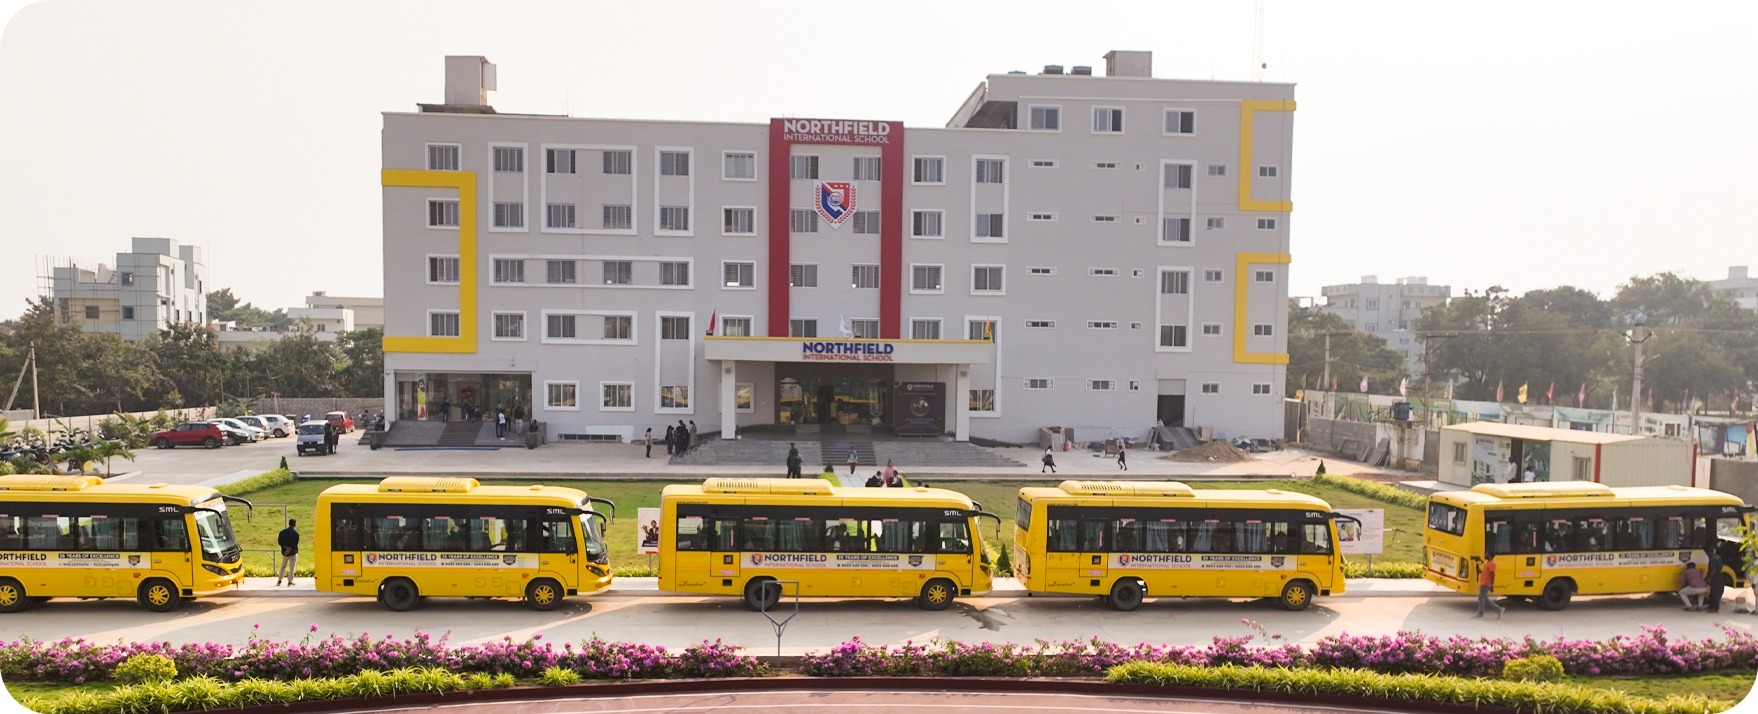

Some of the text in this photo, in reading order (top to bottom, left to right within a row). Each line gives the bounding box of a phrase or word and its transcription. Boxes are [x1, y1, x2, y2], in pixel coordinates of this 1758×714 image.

[784, 119, 890, 135] NORTHFIELD
[783, 133, 890, 144] INTERNATIONAL SCHOOL
[803, 342, 894, 354] NORTHFIELD
[378, 553, 437, 561] NORTHFIELD
[764, 553, 827, 563] NORTHFIELD
[1131, 555, 1192, 563] NORTHFIELD
[1558, 554, 1615, 563] NORTHFIELD
